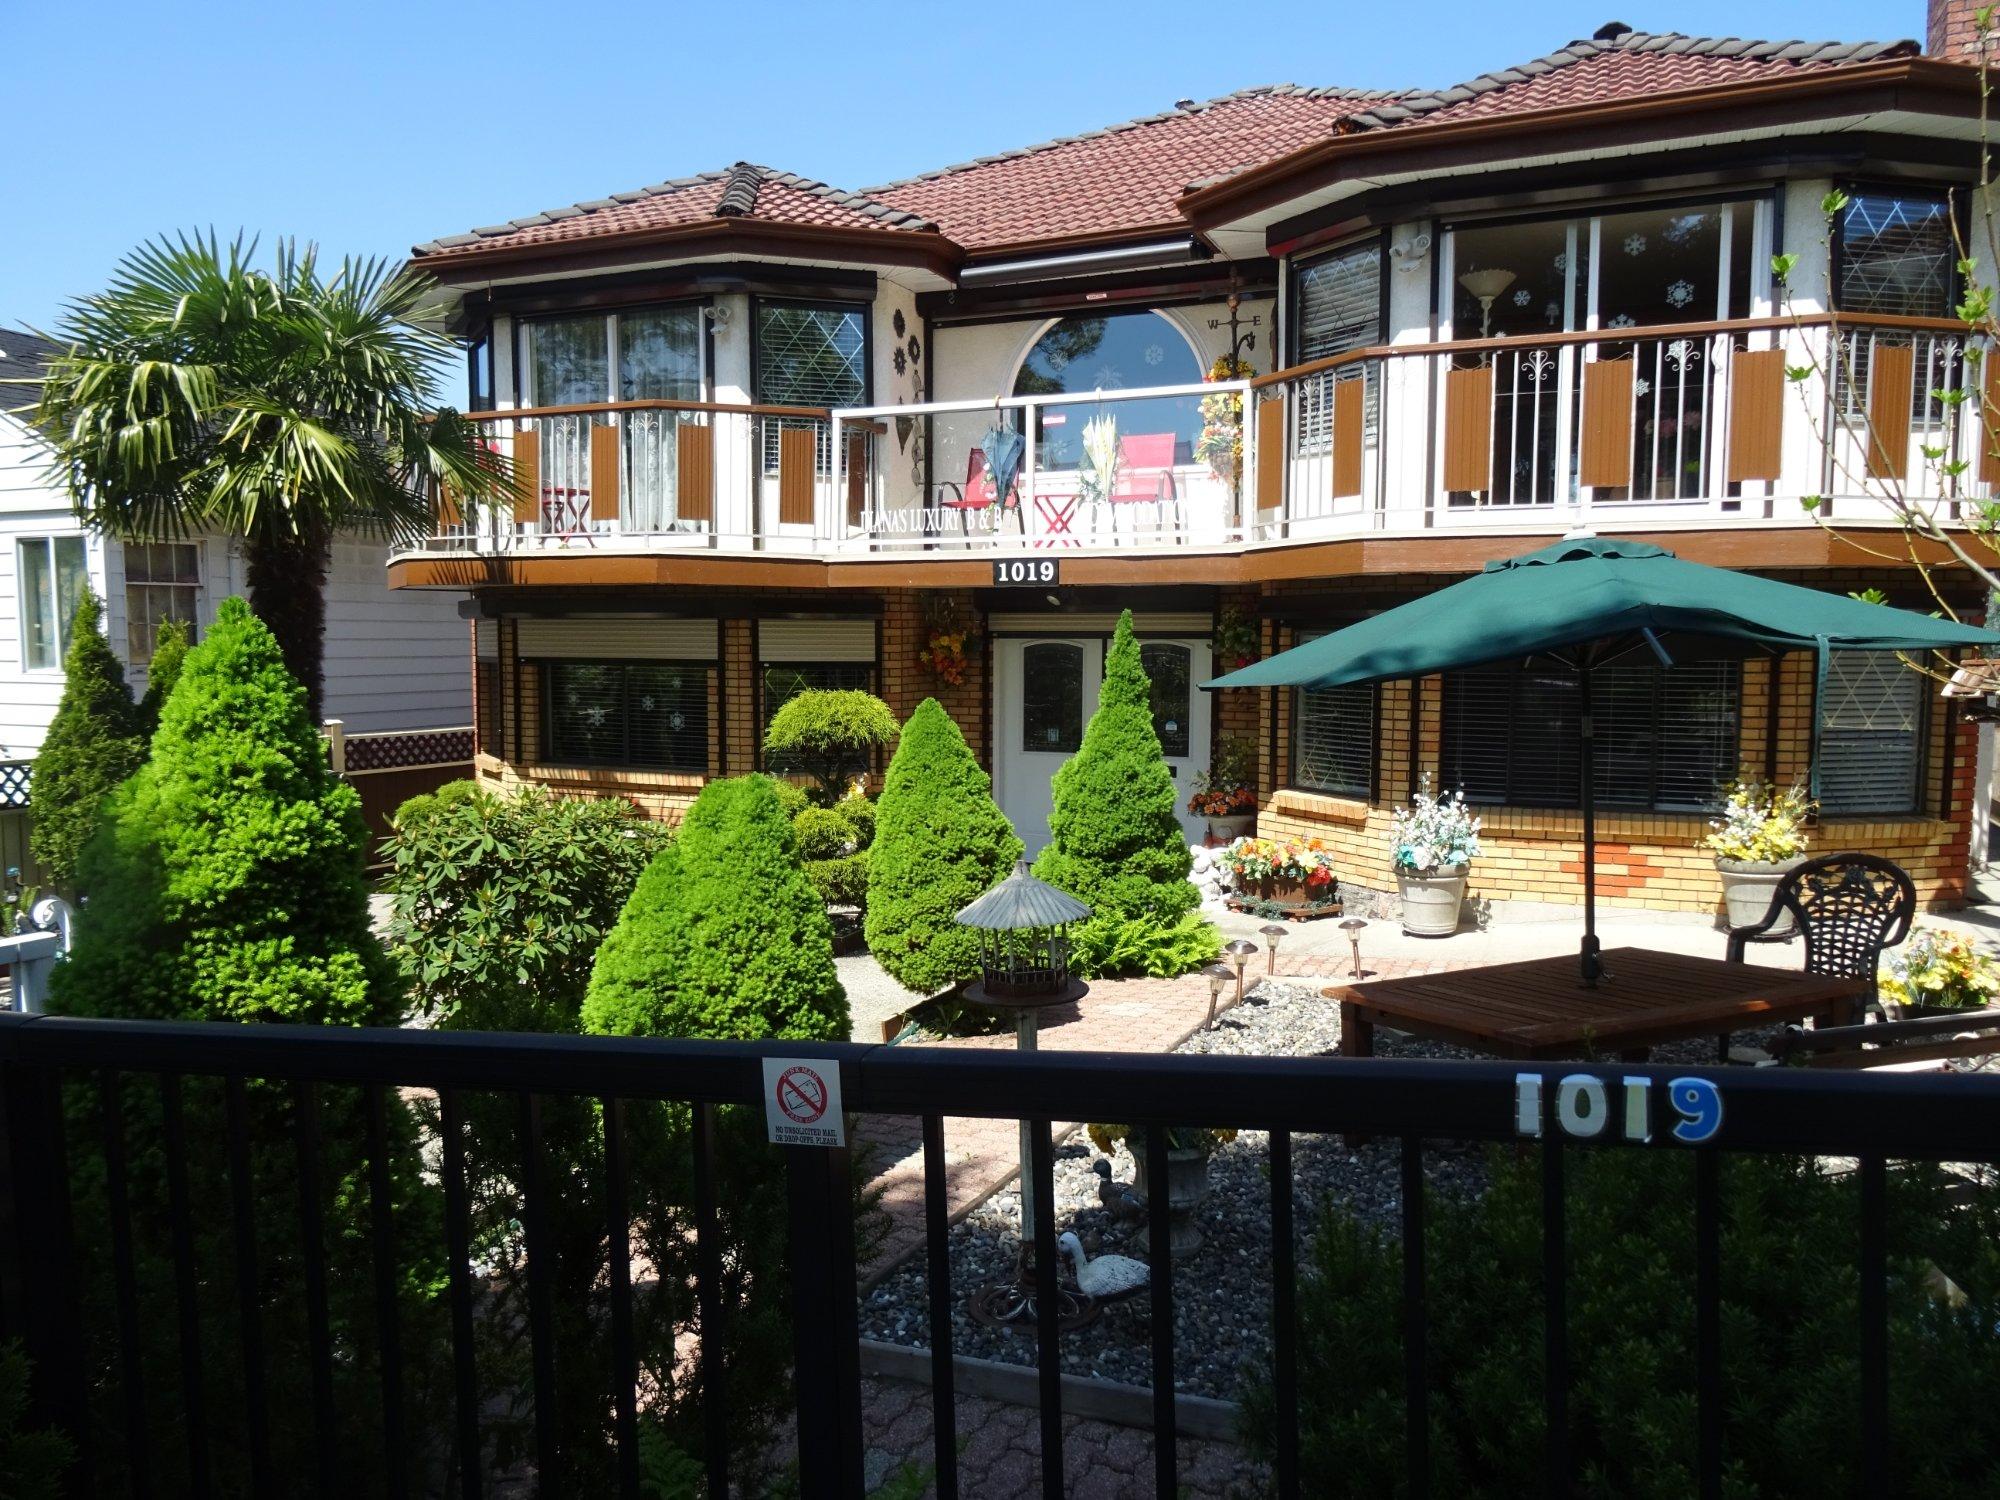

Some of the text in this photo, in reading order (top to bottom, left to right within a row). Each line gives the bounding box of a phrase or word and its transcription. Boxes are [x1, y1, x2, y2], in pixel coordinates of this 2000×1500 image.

[1207, 315, 1261, 329] W E
[910, 508, 961, 531] LUXURY
[967, 507, 976, 530] B
[979, 508, 991, 530] &
[999, 561, 1054, 582] 1019
[783, 1067, 819, 1081] JUNK MAIL
[1516, 1073, 1723, 1142] 1019
[784, 1127, 821, 1136] UNSOLICITED
[816, 1136, 838, 1145] PLEASE
